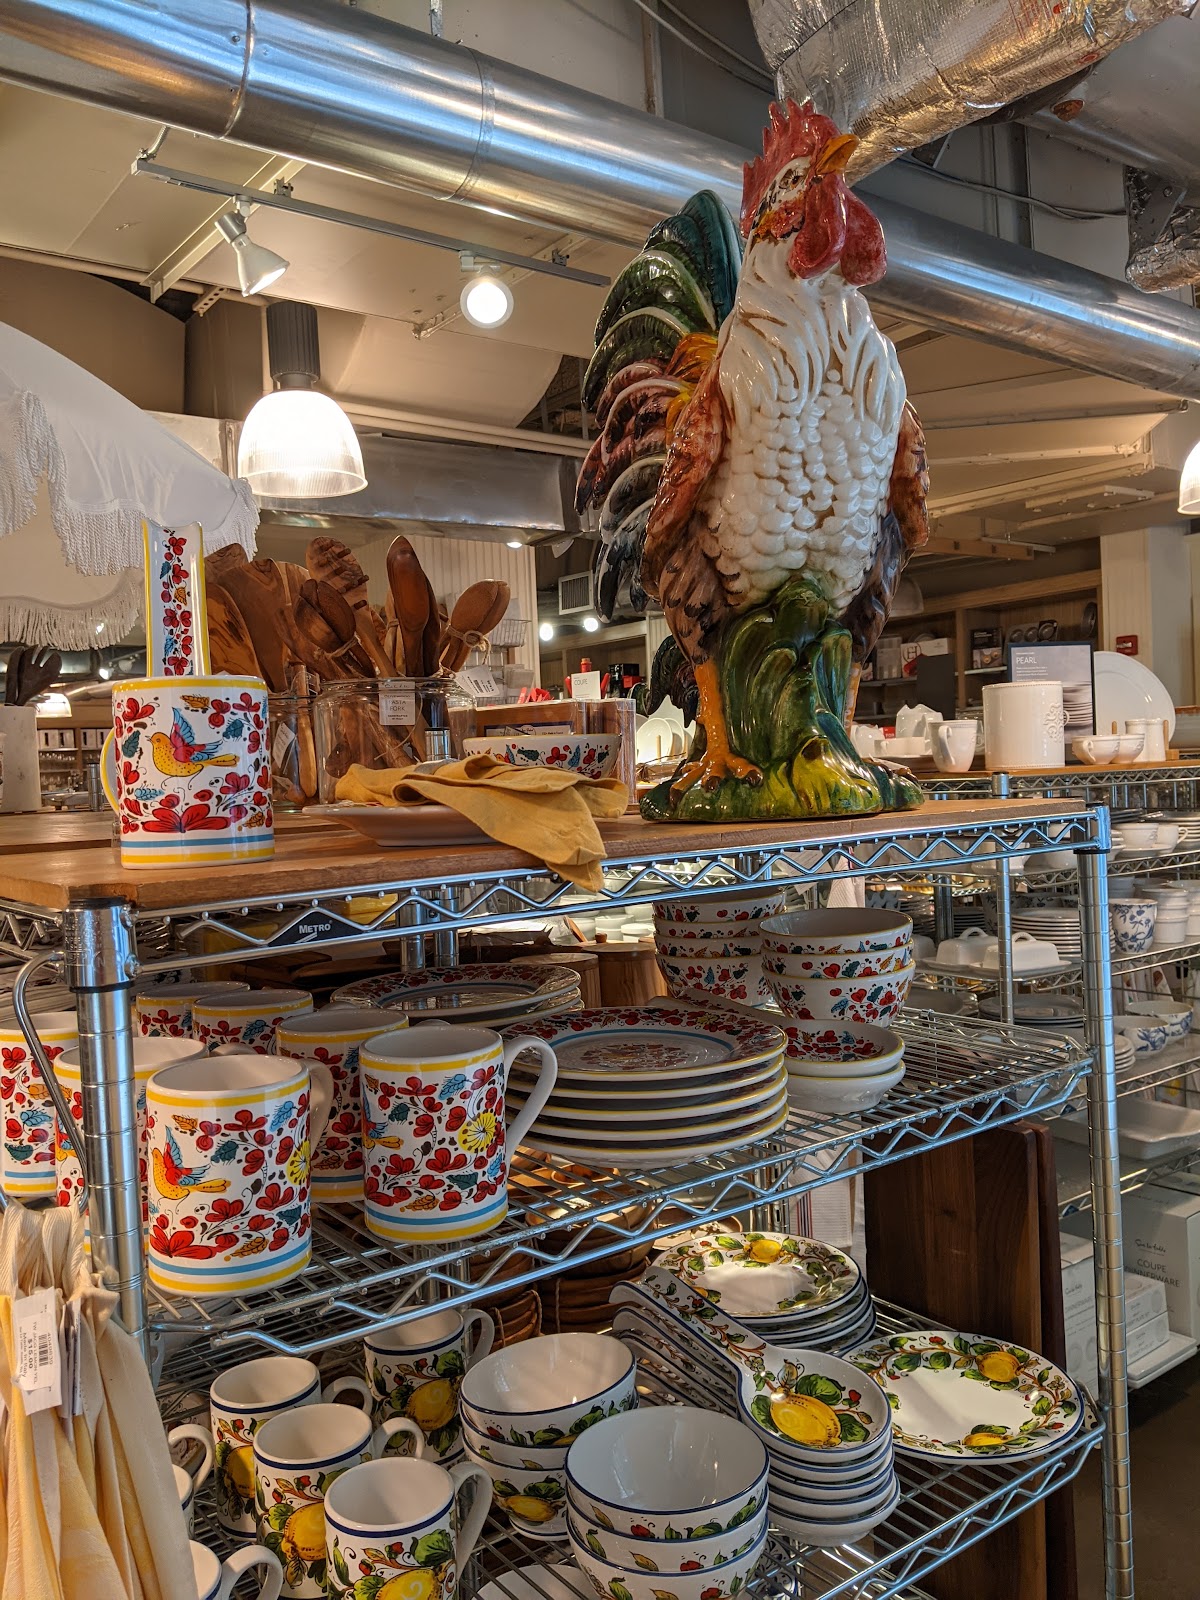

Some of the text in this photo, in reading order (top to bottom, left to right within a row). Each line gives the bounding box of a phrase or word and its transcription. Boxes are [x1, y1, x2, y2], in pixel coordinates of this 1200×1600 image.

[1015, 656, 1038, 665] PEARL
[573, 678, 589, 686] COUPE
[298, 923, 332, 935] METRO
[1136, 1258, 1168, 1274] COUPE
